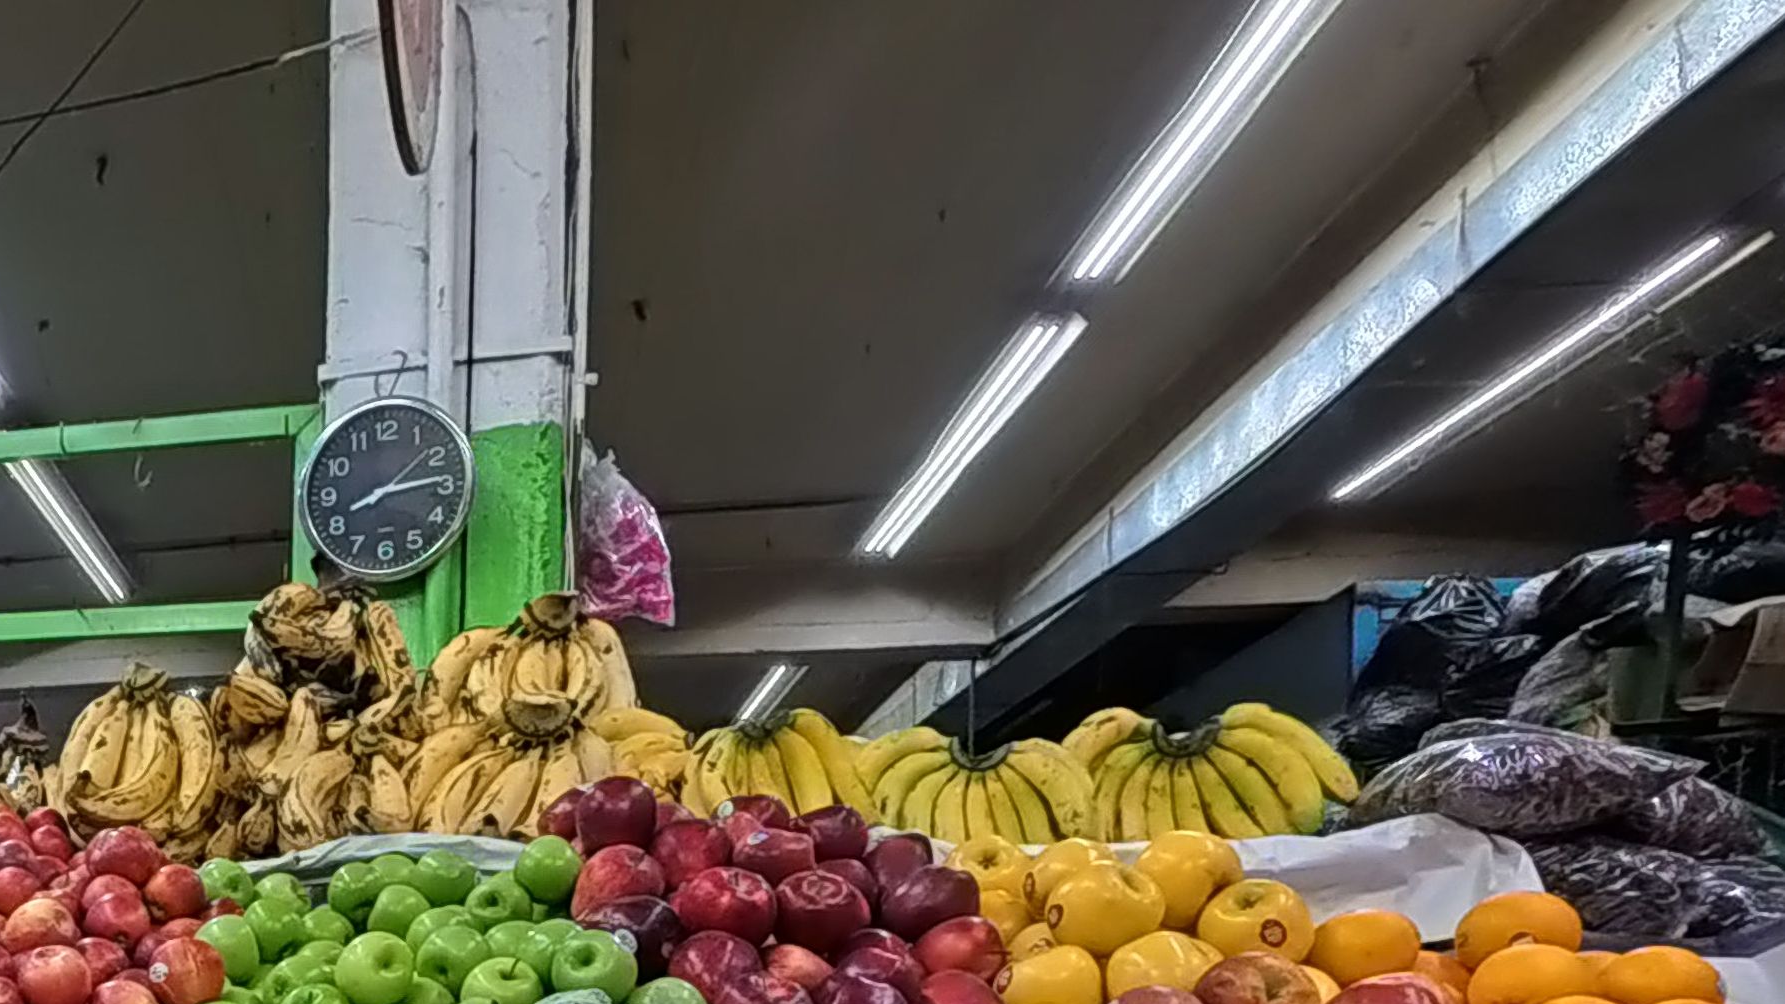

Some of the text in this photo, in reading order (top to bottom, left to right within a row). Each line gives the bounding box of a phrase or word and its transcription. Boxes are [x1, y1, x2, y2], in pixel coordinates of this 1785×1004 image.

[375, 420, 399, 441] 12
[413, 426, 420, 445] 1
[351, 432, 367, 451] 11
[428, 447, 446, 466] 2
[328, 457, 349, 477] 10
[437, 474, 454, 495] 3
[321, 487, 337, 507] 9
[428, 507, 444, 523] 4
[329, 516, 345, 535] 8
[350, 535, 366, 554] 7
[406, 529, 423, 549] 5
[378, 541, 394, 560] 6
